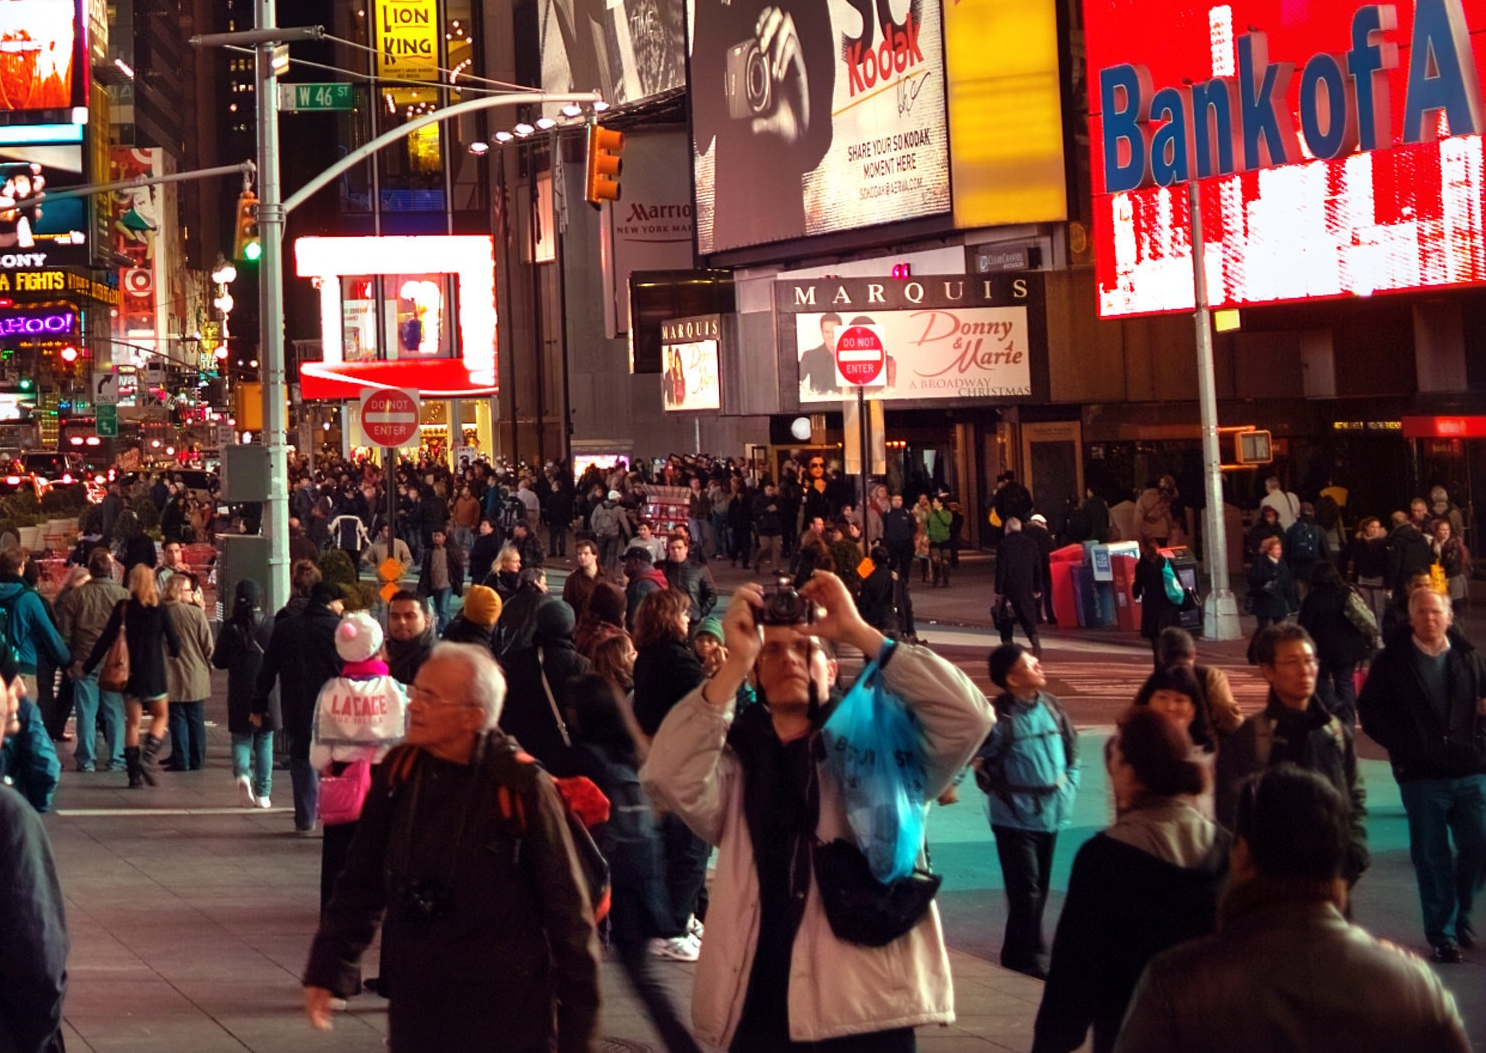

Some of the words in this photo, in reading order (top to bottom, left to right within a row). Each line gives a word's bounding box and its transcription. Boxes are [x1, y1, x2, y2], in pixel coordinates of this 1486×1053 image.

[383, 5, 429, 33] LION
[383, 37, 432, 66] KING
[846, 12, 925, 99] Kodak
[299, 87, 313, 107] W
[315, 86, 333, 107] 46
[337, 85, 350, 99] ST
[1100, 30, 1296, 195] Bank
[1299, 3, 1399, 161] of
[848, 141, 872, 163] SHARE
[872, 137, 893, 157] YOUR
[893, 134, 904, 152] SO
[904, 128, 932, 150] KODAK
[863, 157, 895, 179] MOMENT
[896, 153, 917, 173] HERE
[617, 226, 640, 234] NEW
[642, 225, 668, 234] YORK
[15, 271, 65, 292] FIGHTS
[794, 279, 1029, 305] MARQUIS
[662, 321, 719, 340] MARQUIS
[910, 311, 1013, 348] Donny
[843, 337, 857, 349] DO
[858, 337, 875, 349] NOT
[845, 361, 875, 375] ENTER
[915, 336, 1023, 379] Marie
[920, 378, 992, 390] BROADWAY
[958, 385, 1032, 399] CHRISTMAS
[97, 395, 115, 403] ONLY
[372, 400, 385, 409] DO
[388, 400, 409, 409] NOT
[374, 425, 406, 435] ENTER
[331, 695, 352, 715] LA
